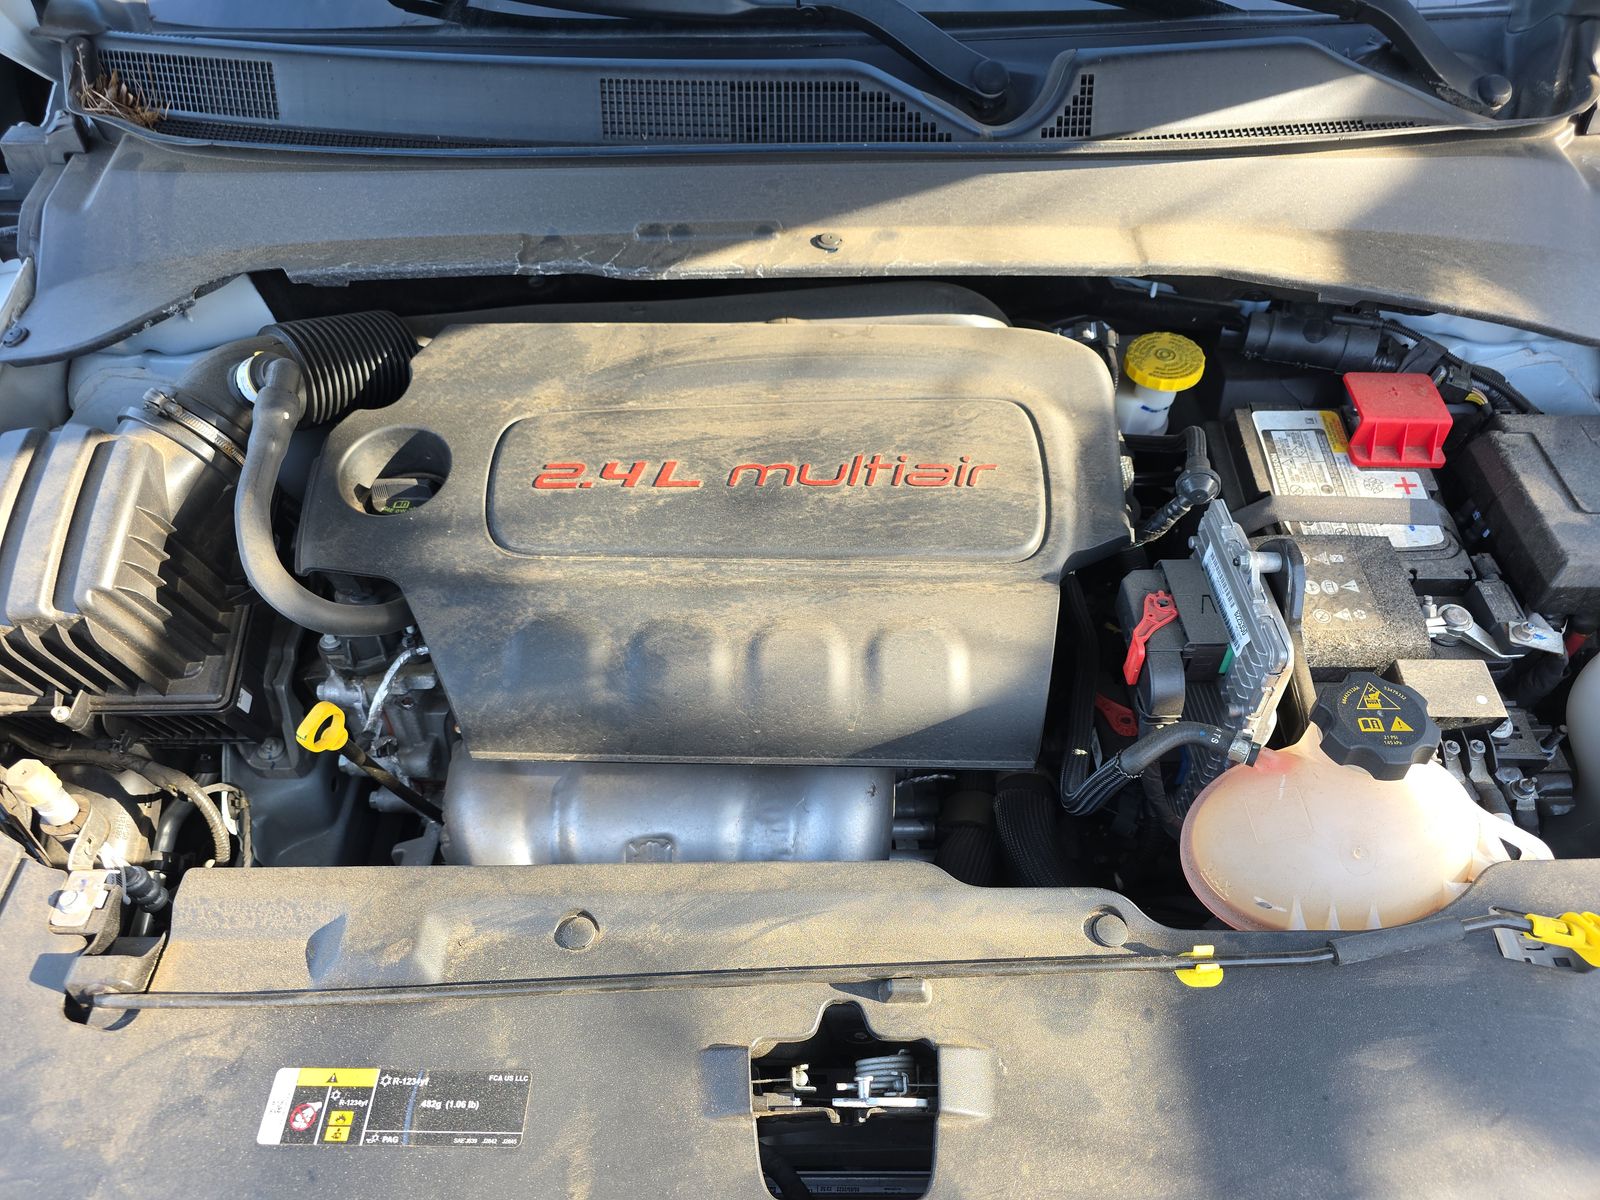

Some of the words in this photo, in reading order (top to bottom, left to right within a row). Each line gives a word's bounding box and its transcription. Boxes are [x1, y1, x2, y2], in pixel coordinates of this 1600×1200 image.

[726, 454, 998, 488] multiair
[488, 1074, 503, 1082] FCA
[515, 1075, 529, 1083] LLC
[382, 1136, 399, 1144] PAG
